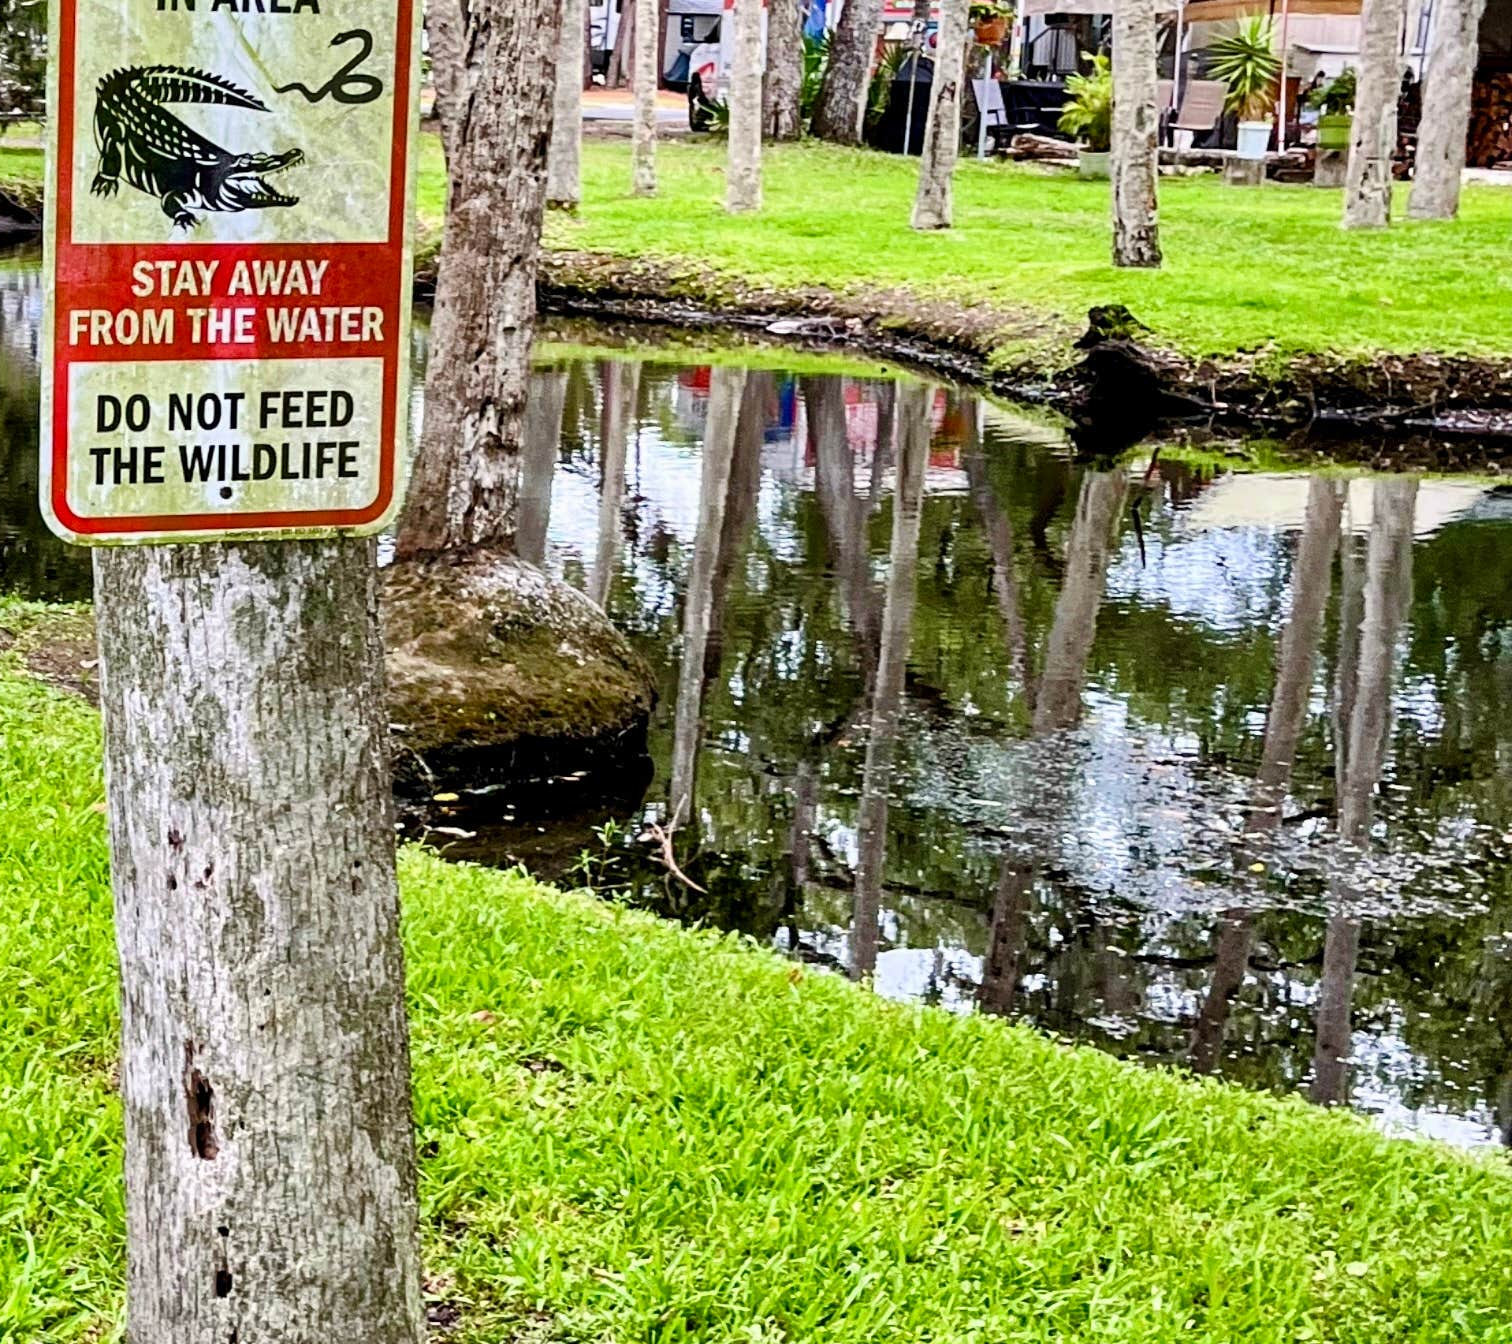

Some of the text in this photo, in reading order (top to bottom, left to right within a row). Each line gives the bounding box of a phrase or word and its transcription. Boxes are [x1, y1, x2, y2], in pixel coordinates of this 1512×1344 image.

[131, 260, 329, 297] STAY AWAY
[69, 307, 384, 345] FROM THE WATER
[97, 391, 353, 432] DO NOT FEED
[90, 441, 360, 485] THE WILDLIFE
